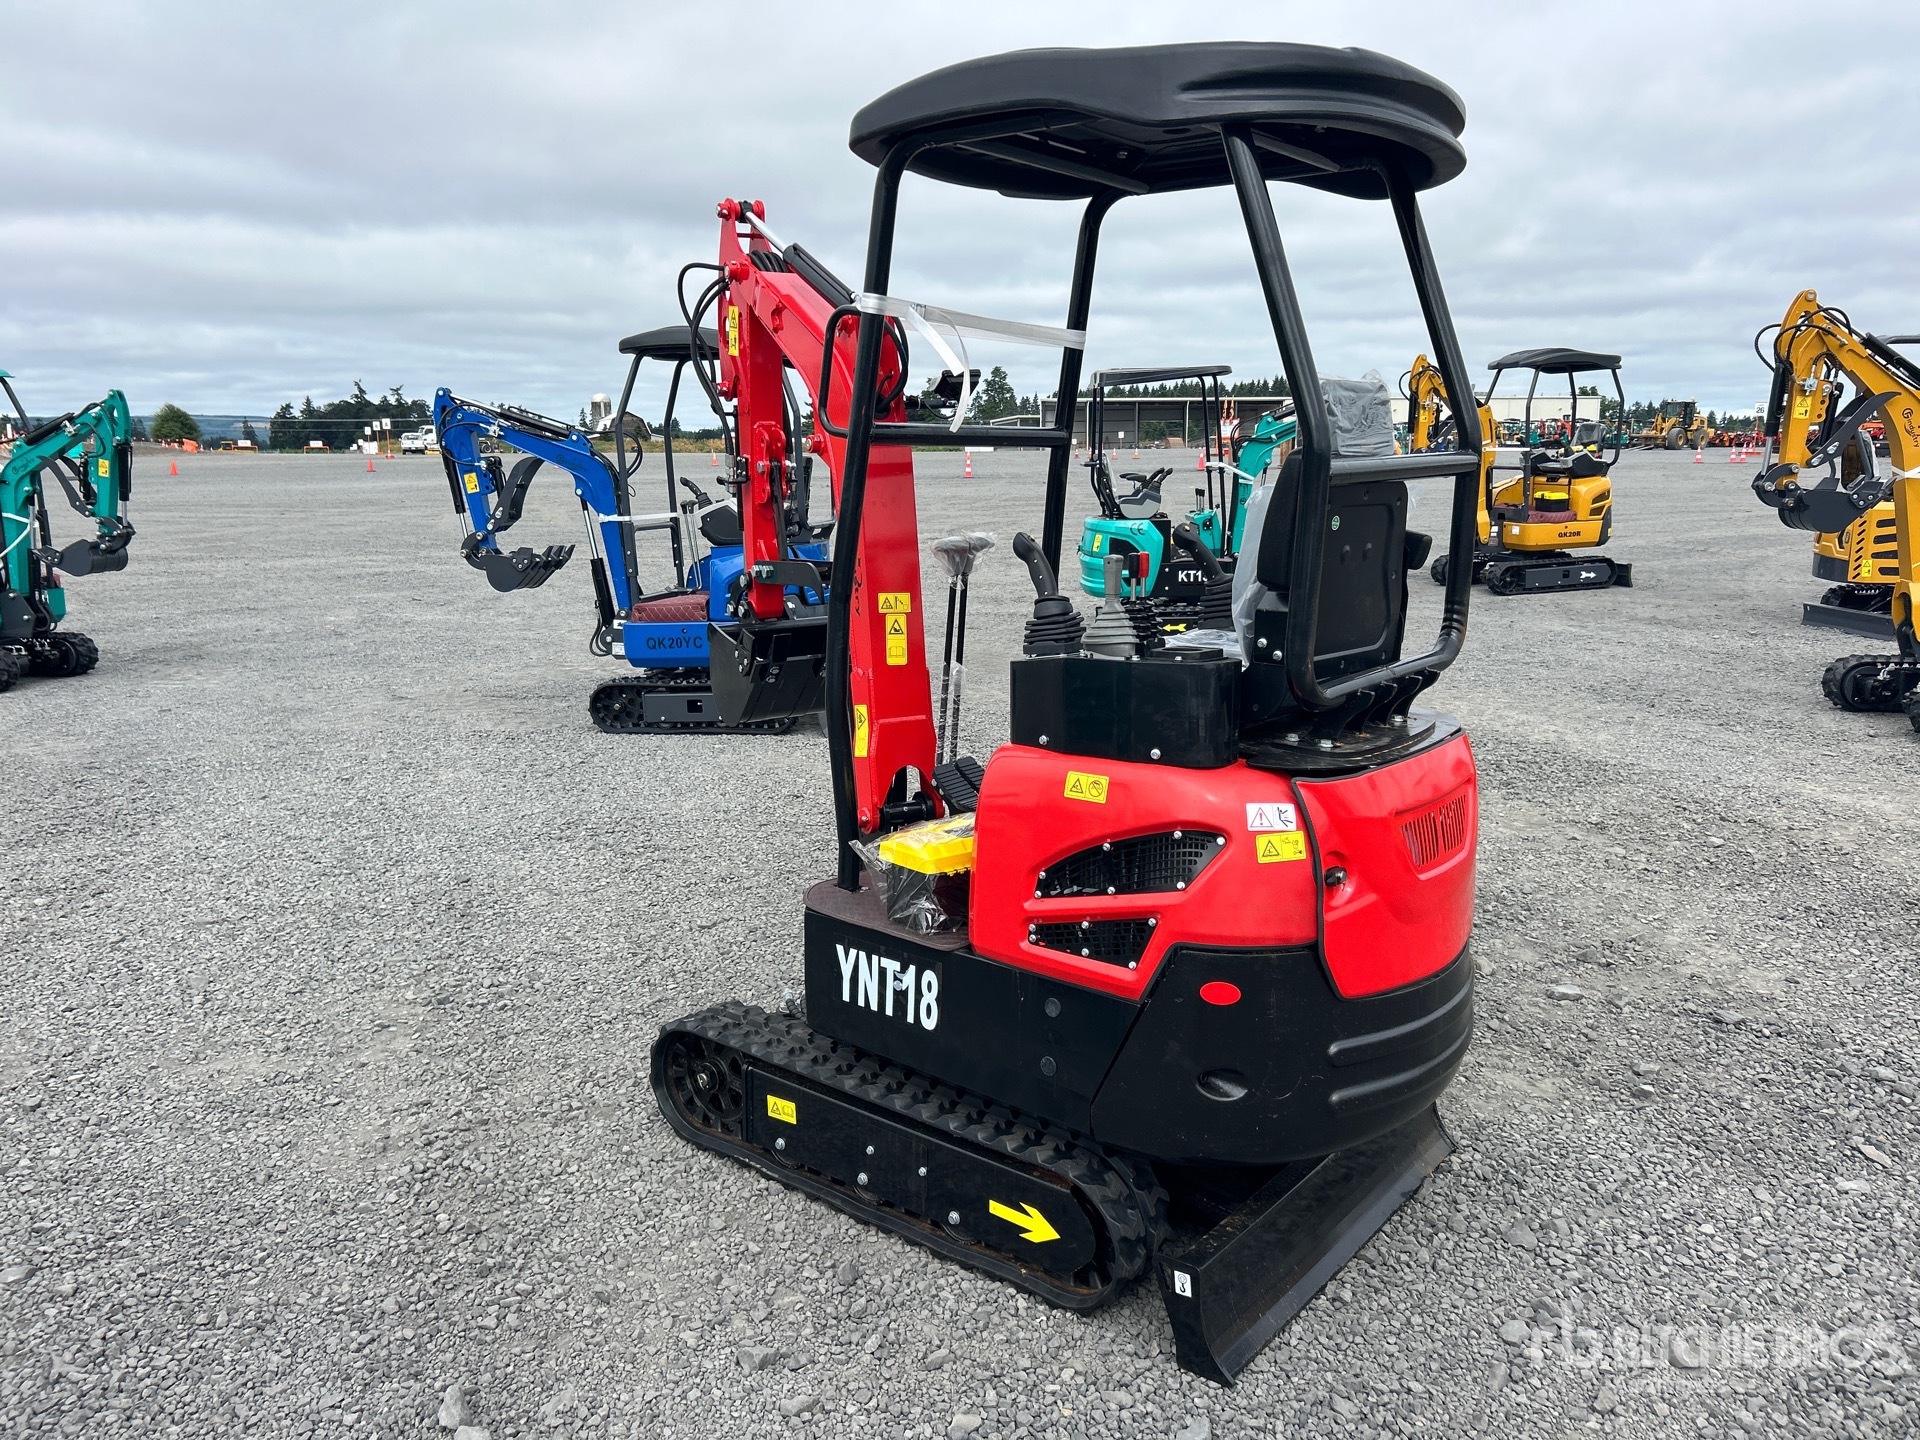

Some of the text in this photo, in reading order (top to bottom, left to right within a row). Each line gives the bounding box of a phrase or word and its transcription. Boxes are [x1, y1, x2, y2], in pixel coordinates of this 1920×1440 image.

[1755, 406, 1765, 414] 26
[646, 636, 703, 650] QK20YC
[835, 943, 939, 1031] YNT18
